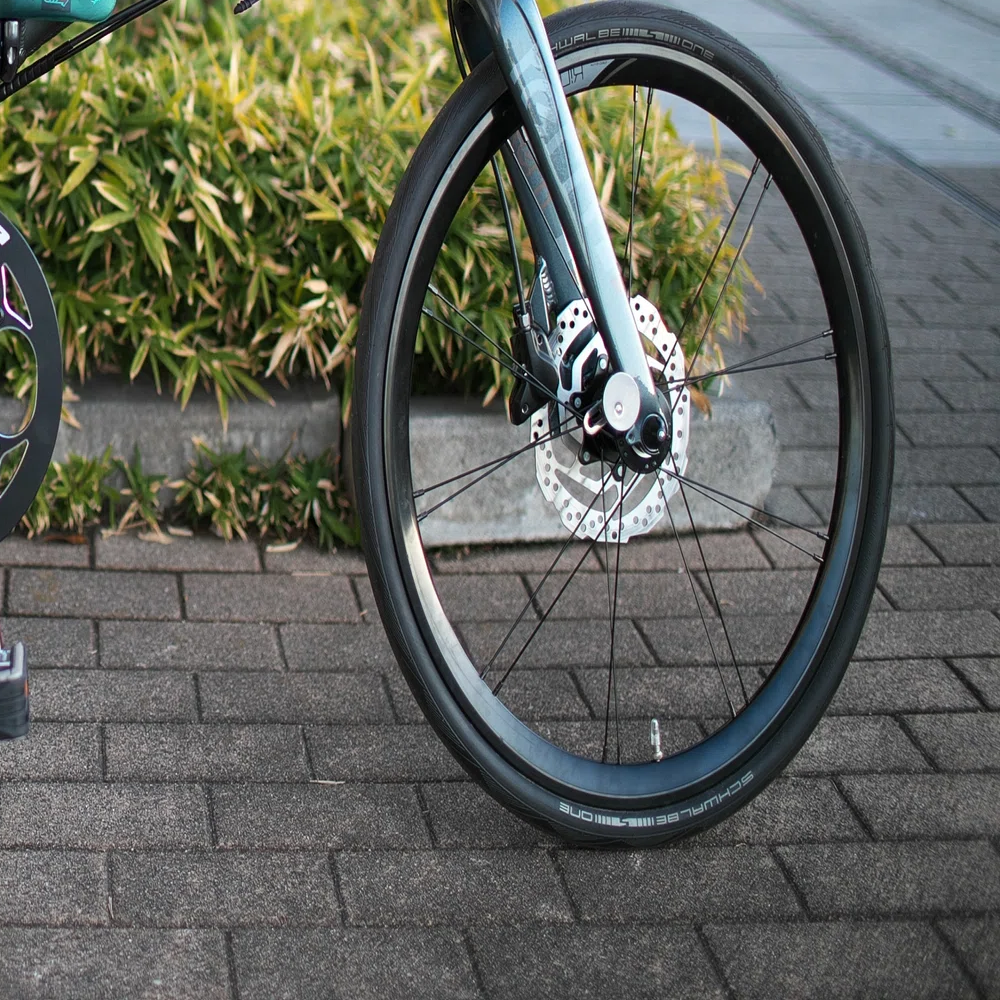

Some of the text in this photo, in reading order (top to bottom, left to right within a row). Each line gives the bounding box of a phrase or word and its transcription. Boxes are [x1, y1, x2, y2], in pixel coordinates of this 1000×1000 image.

[682, 39, 715, 61] ONE
[559, 770, 754, 825] SCHWALBE ONE
